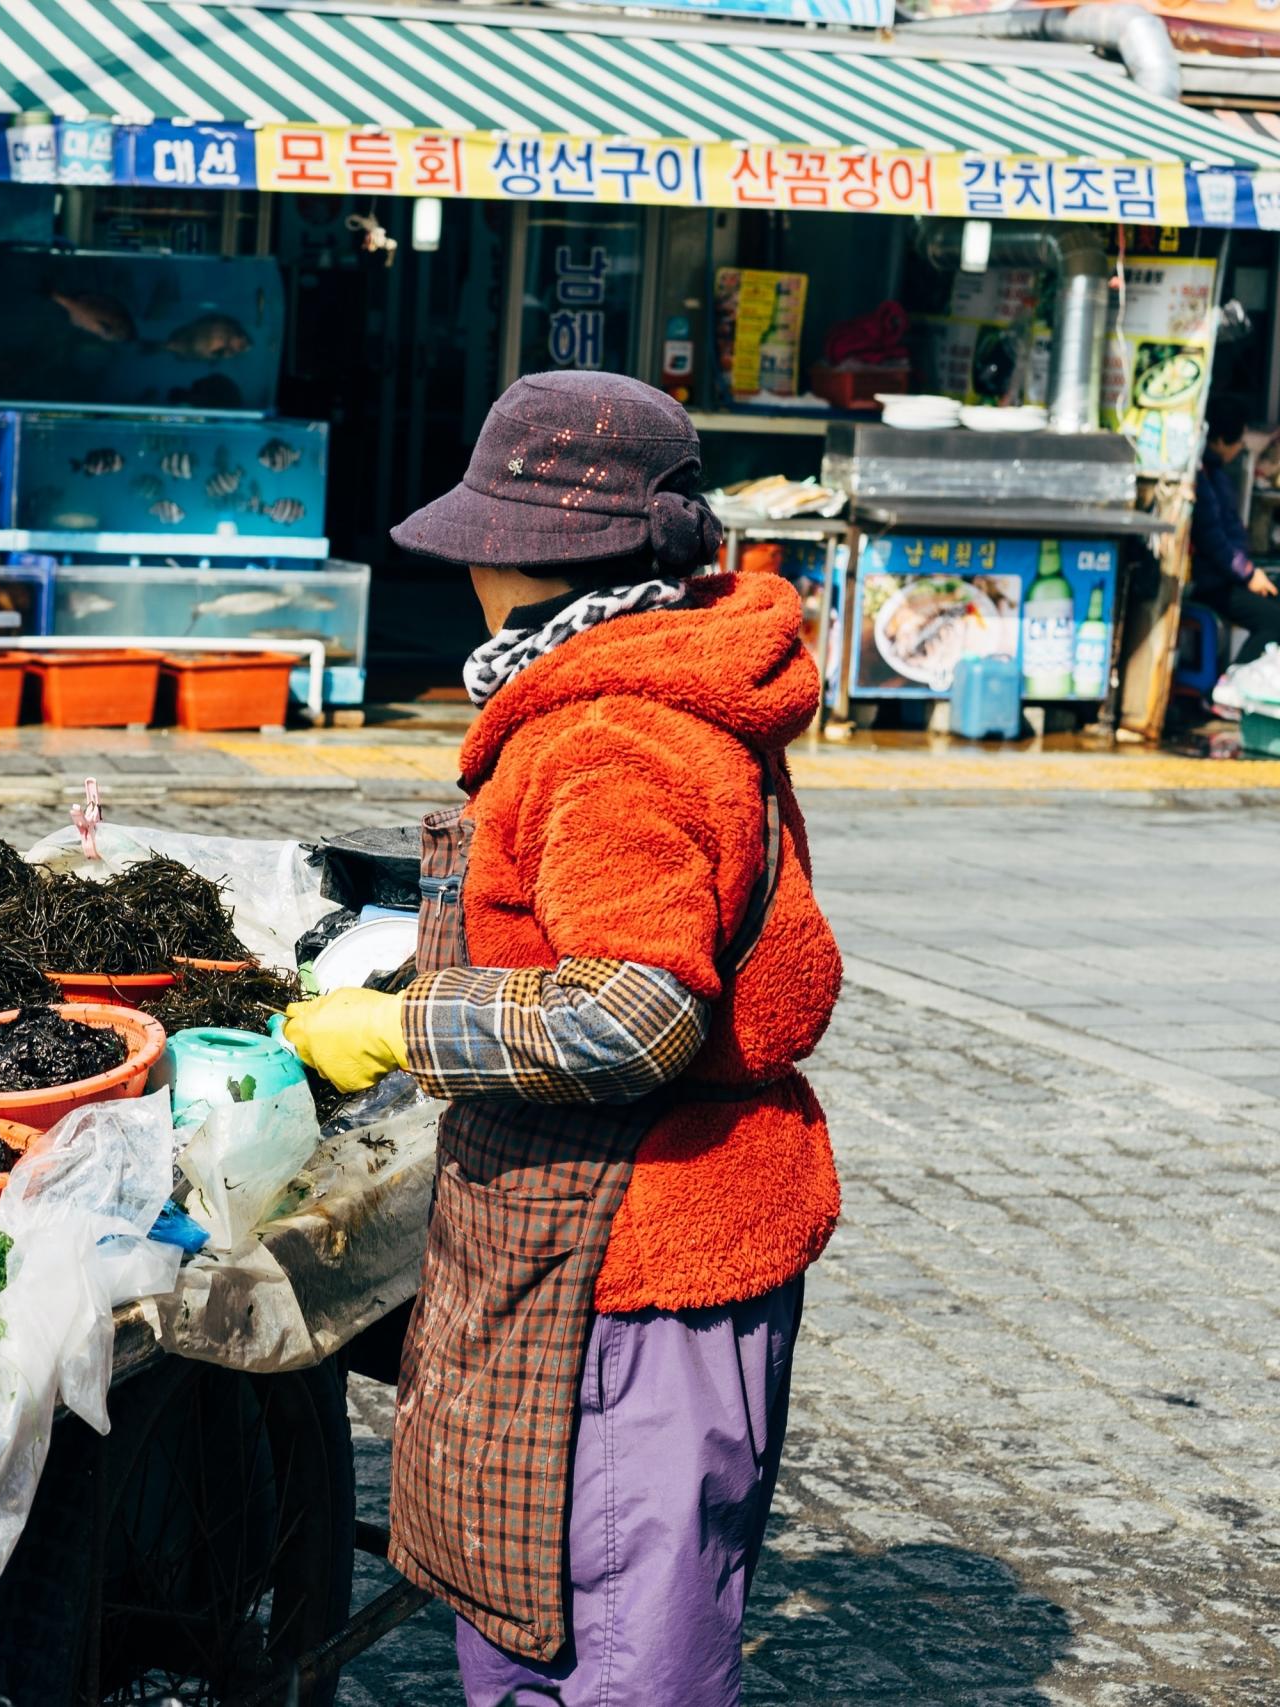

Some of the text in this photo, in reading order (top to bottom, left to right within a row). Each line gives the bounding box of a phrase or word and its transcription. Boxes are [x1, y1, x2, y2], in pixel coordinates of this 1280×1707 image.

[153, 139, 240, 185] 대선
[276, 134, 1156, 218] 모듬회 생선구이 산꼼장어 갈치조림
[549, 246, 606, 369] 남해
